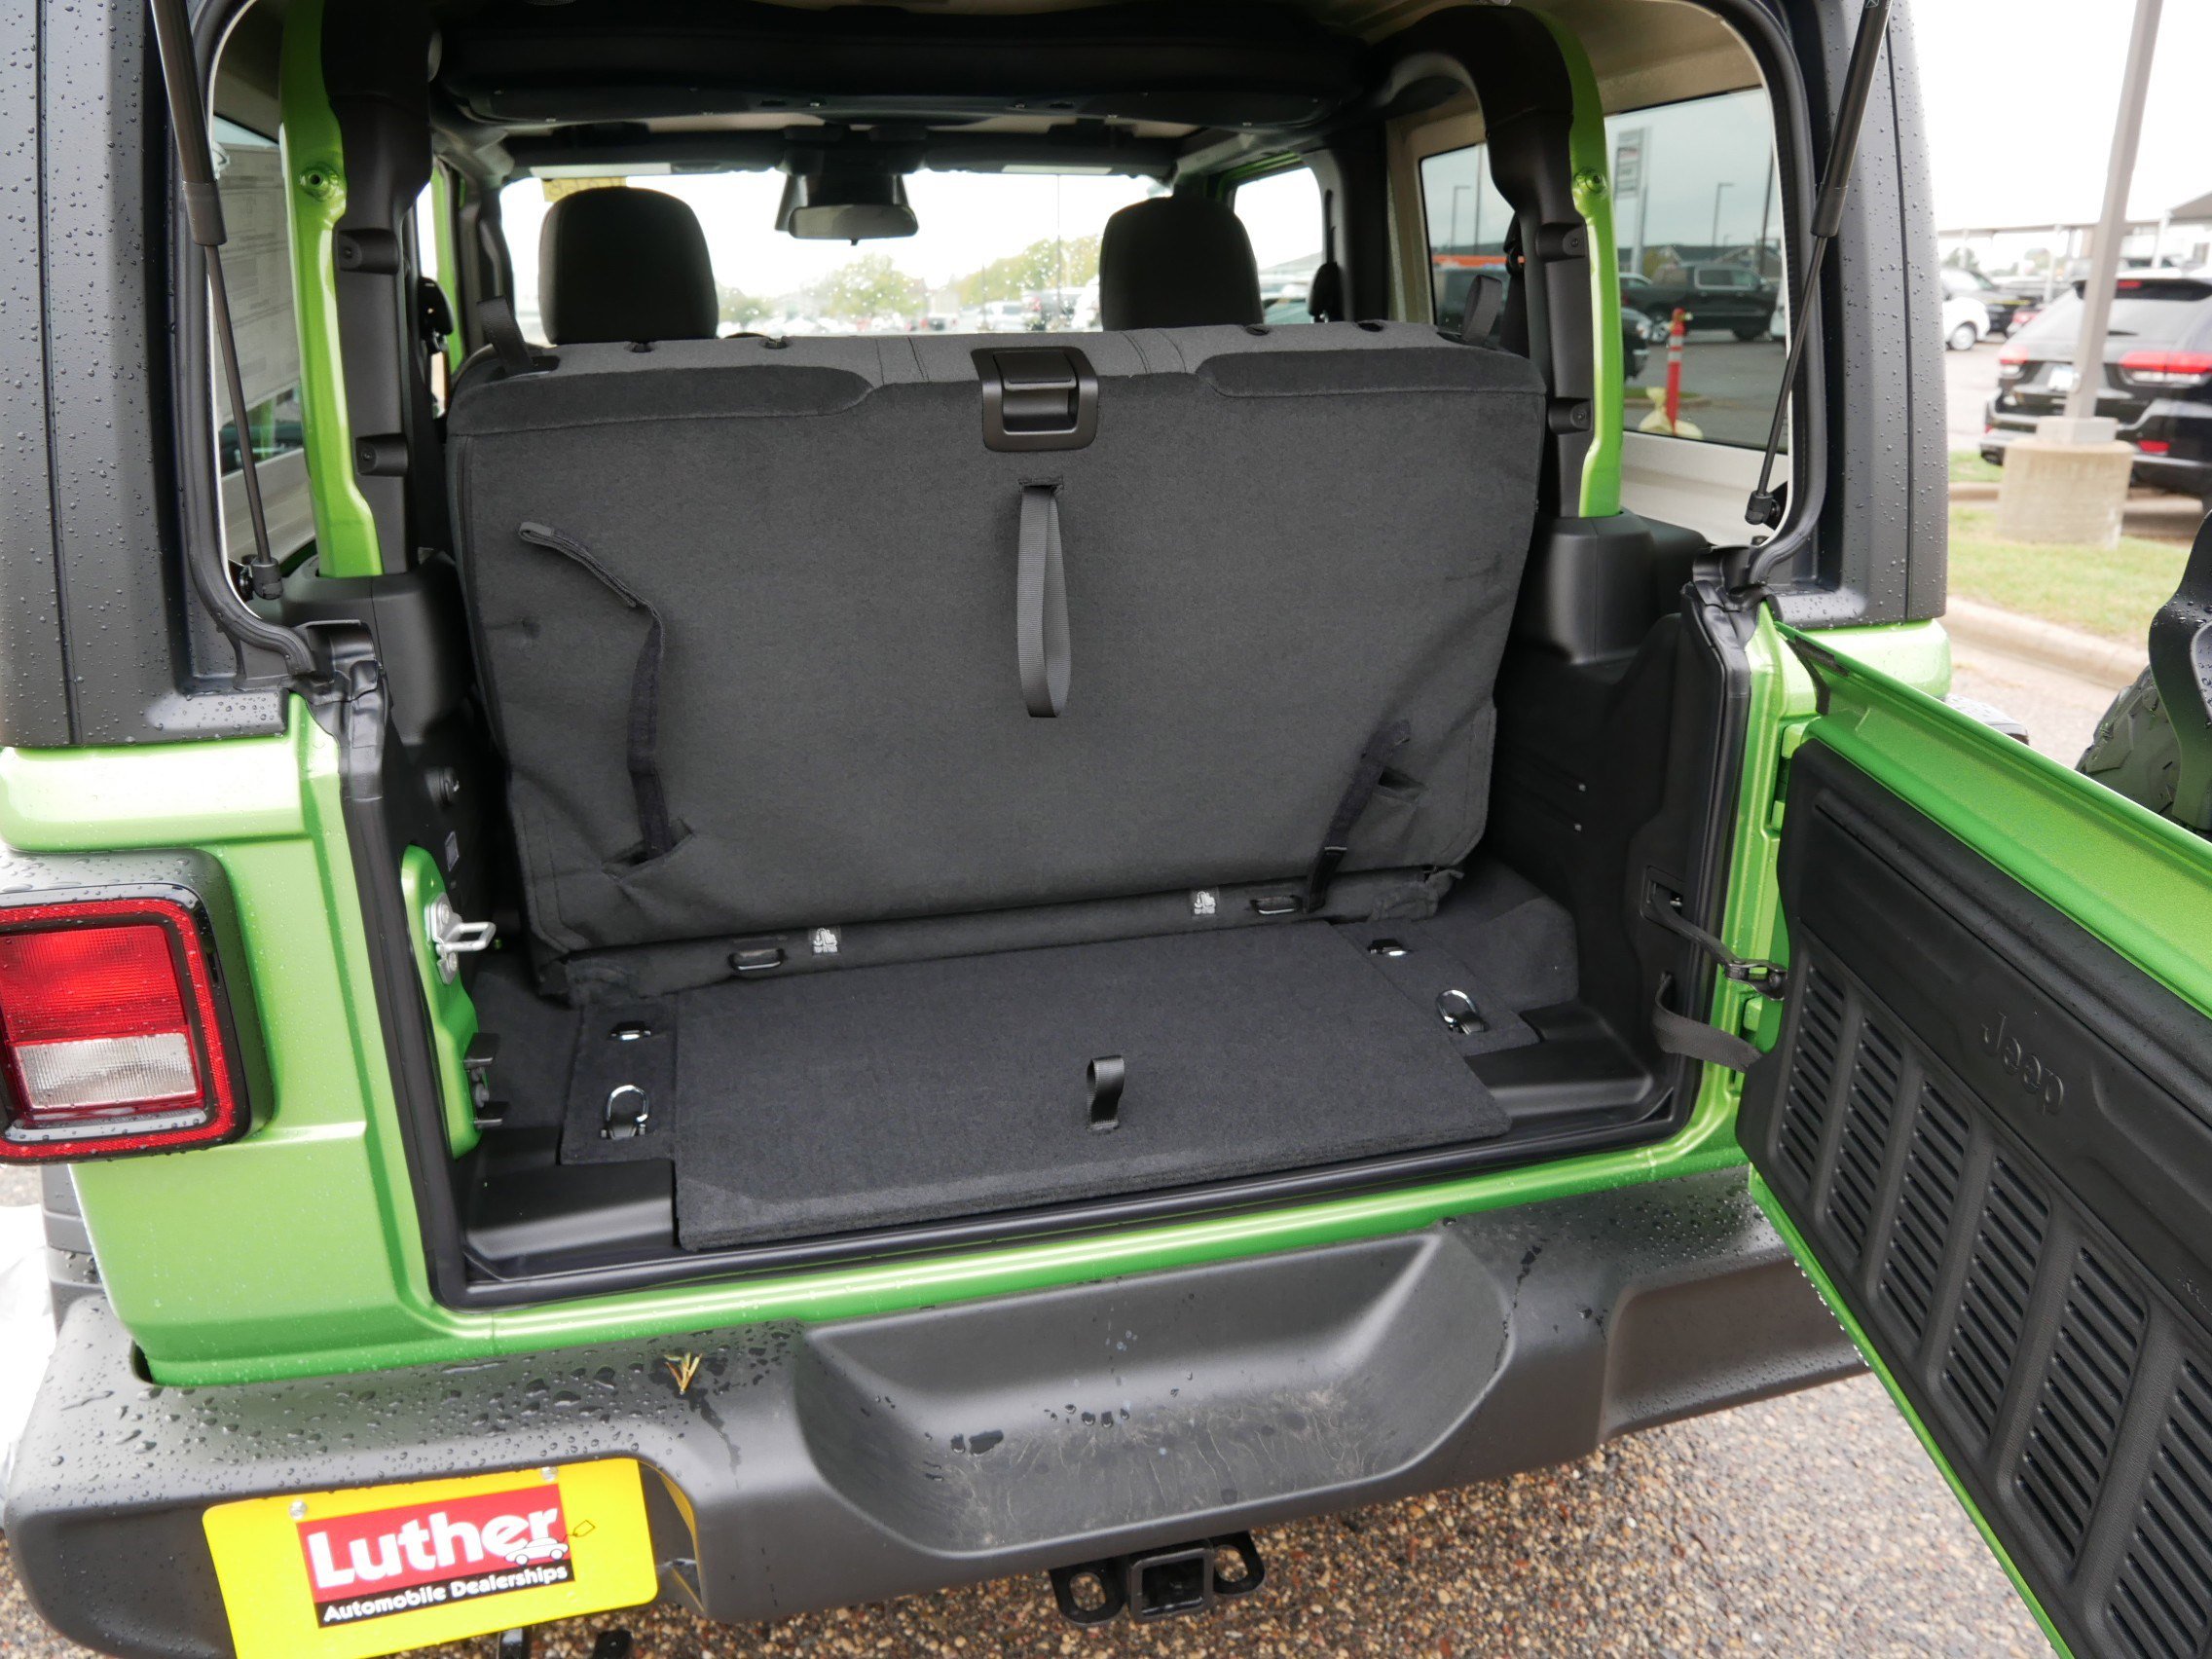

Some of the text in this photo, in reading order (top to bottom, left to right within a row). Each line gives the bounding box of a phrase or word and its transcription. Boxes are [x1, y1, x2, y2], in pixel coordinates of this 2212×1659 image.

[1979, 1011, 2064, 1117] Jeep
[308, 1507, 559, 1589] Luther
[322, 1566, 568, 1622] Automobile Dealerships
